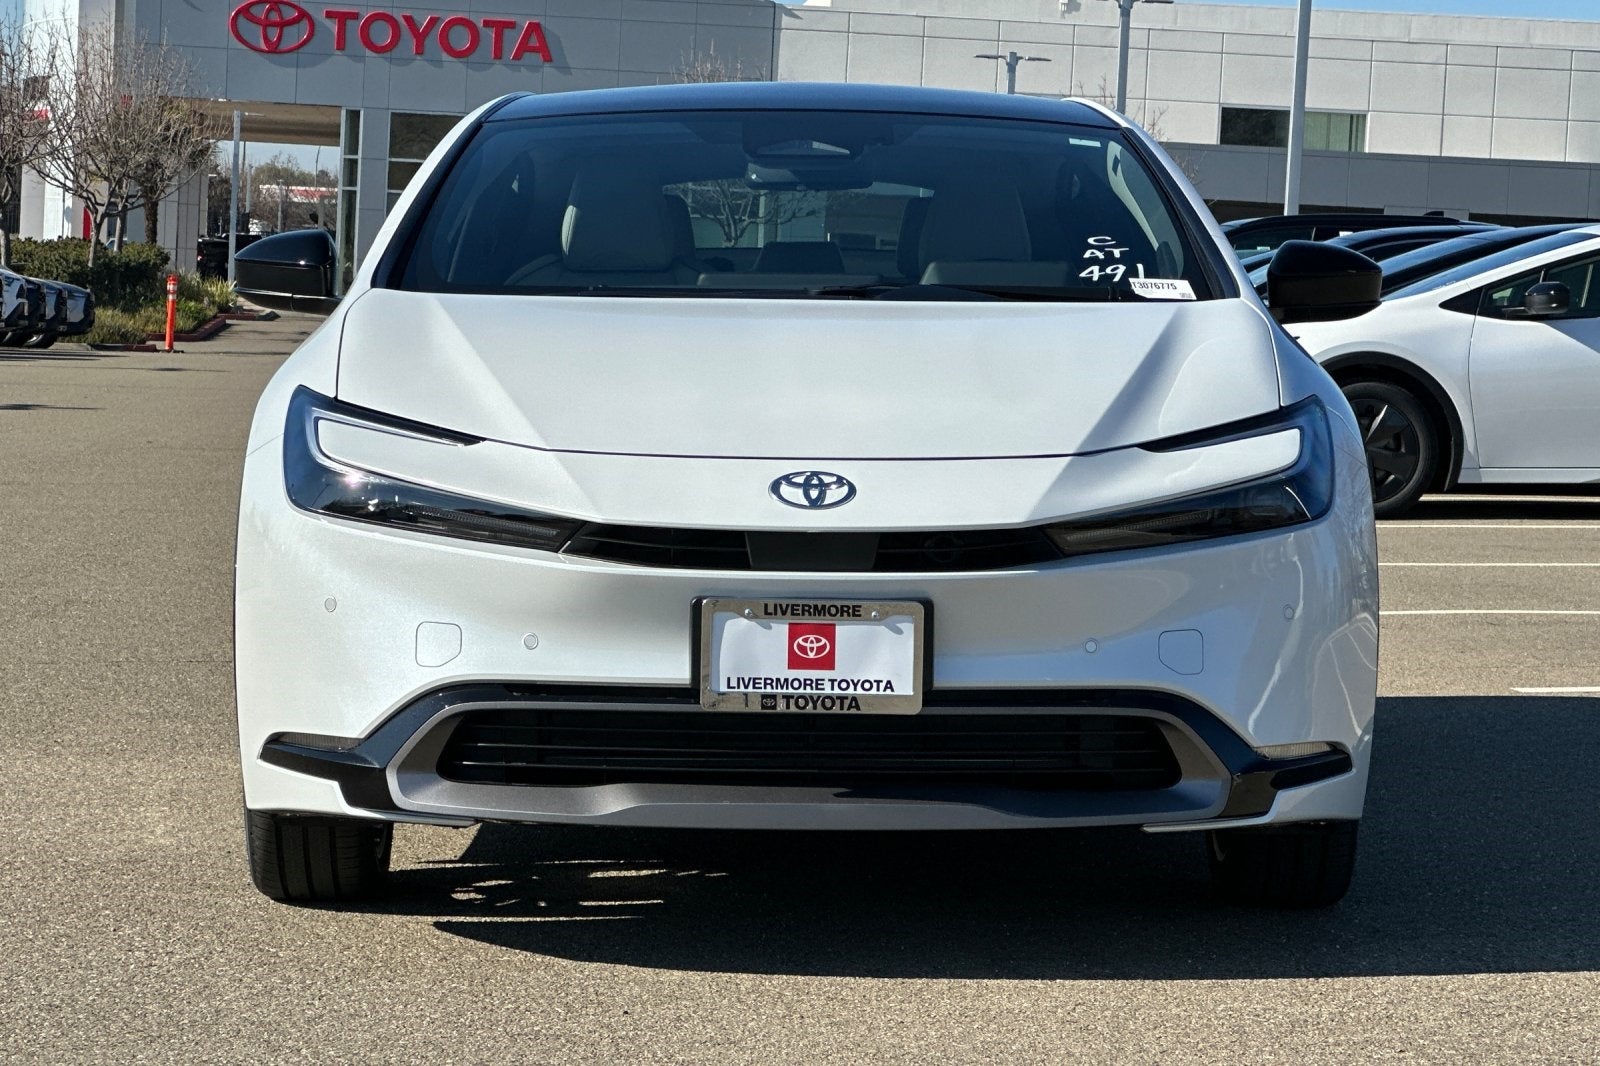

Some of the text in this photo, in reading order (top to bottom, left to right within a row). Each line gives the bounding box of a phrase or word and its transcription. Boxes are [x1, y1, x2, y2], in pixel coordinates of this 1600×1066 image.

[324, 9, 553, 63] TOYOTA
[1087, 236, 1116, 245] C
[1083, 248, 1129, 259] AT
[763, 603, 862, 618] LIVERMORE
[726, 677, 895, 693] LIVERMORE TOYOTA
[782, 695, 861, 711] TOYOTA
